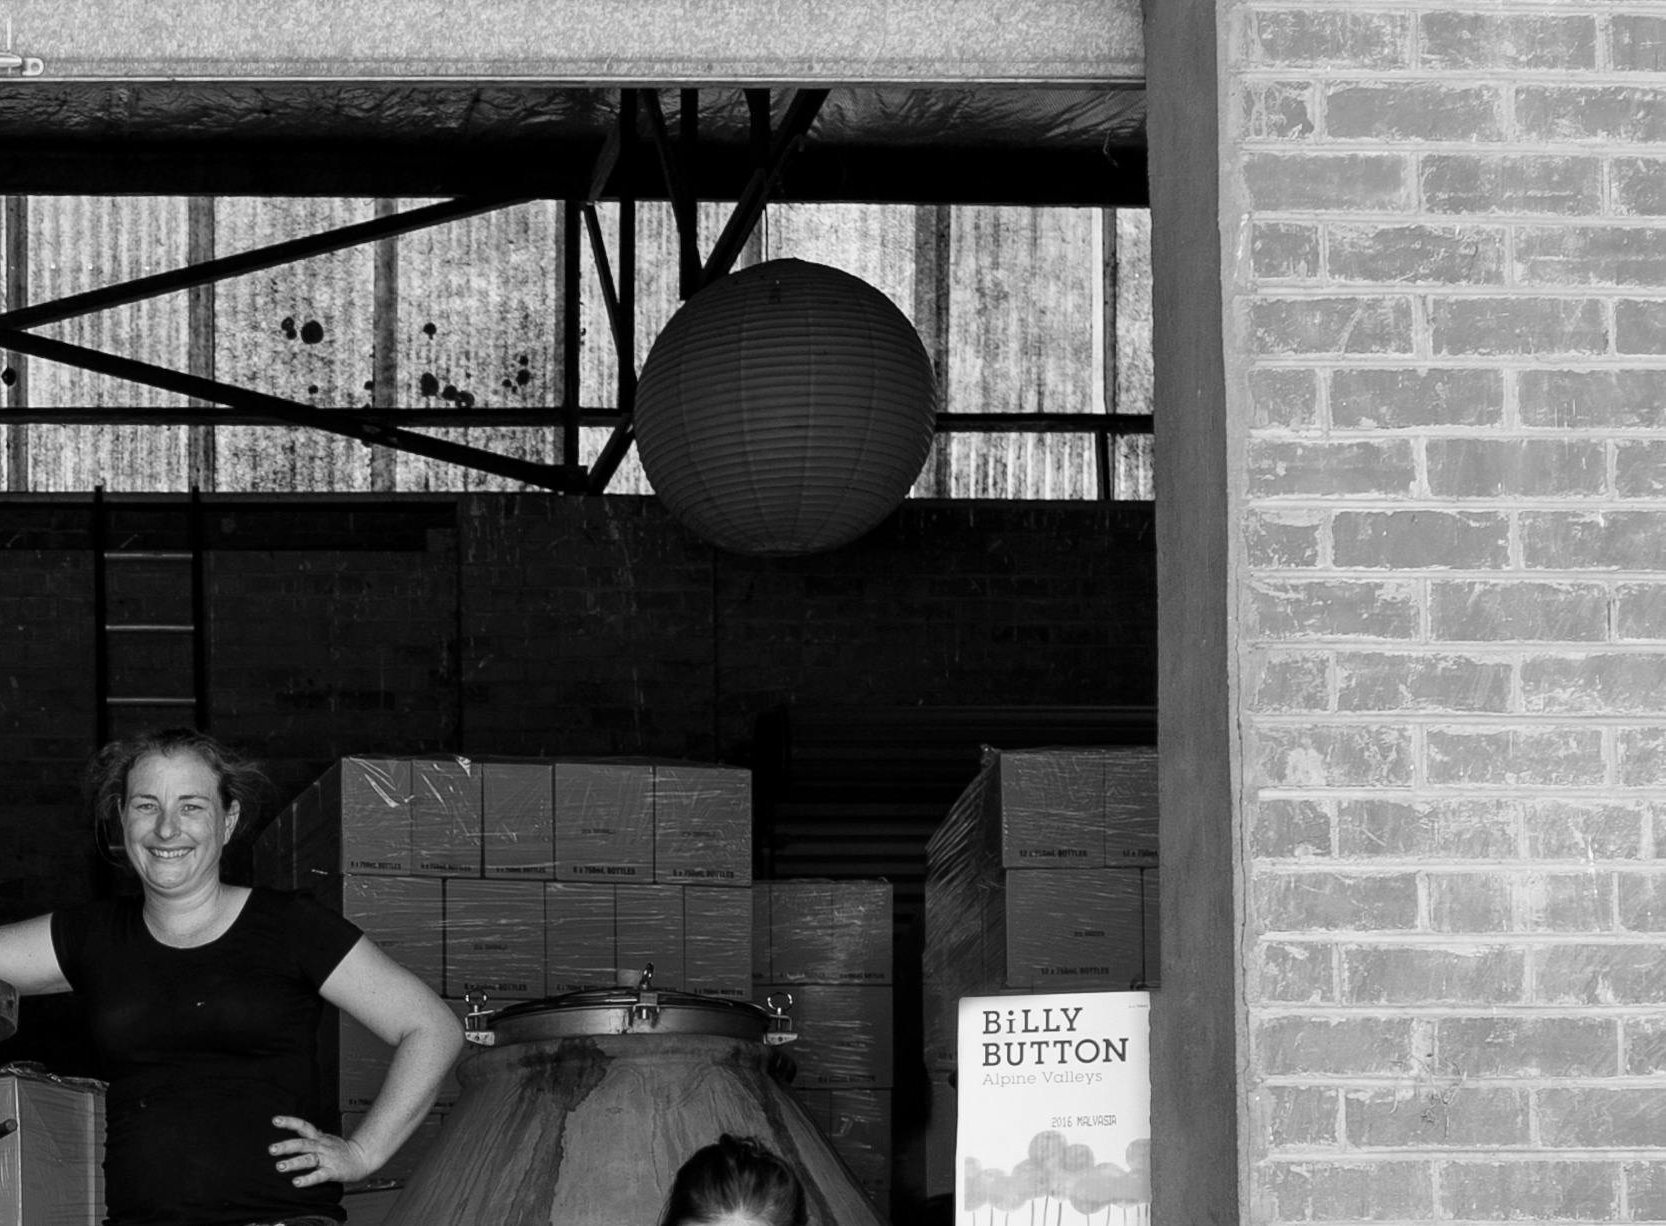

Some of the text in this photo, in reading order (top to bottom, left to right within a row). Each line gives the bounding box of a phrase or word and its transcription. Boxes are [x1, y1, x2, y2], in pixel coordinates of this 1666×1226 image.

[982, 1038, 1129, 1067] BUTTON
[982, 1070, 1103, 1088] Alpine Valleys
[1051, 1114, 1117, 1128] 2016 MALVASIA
